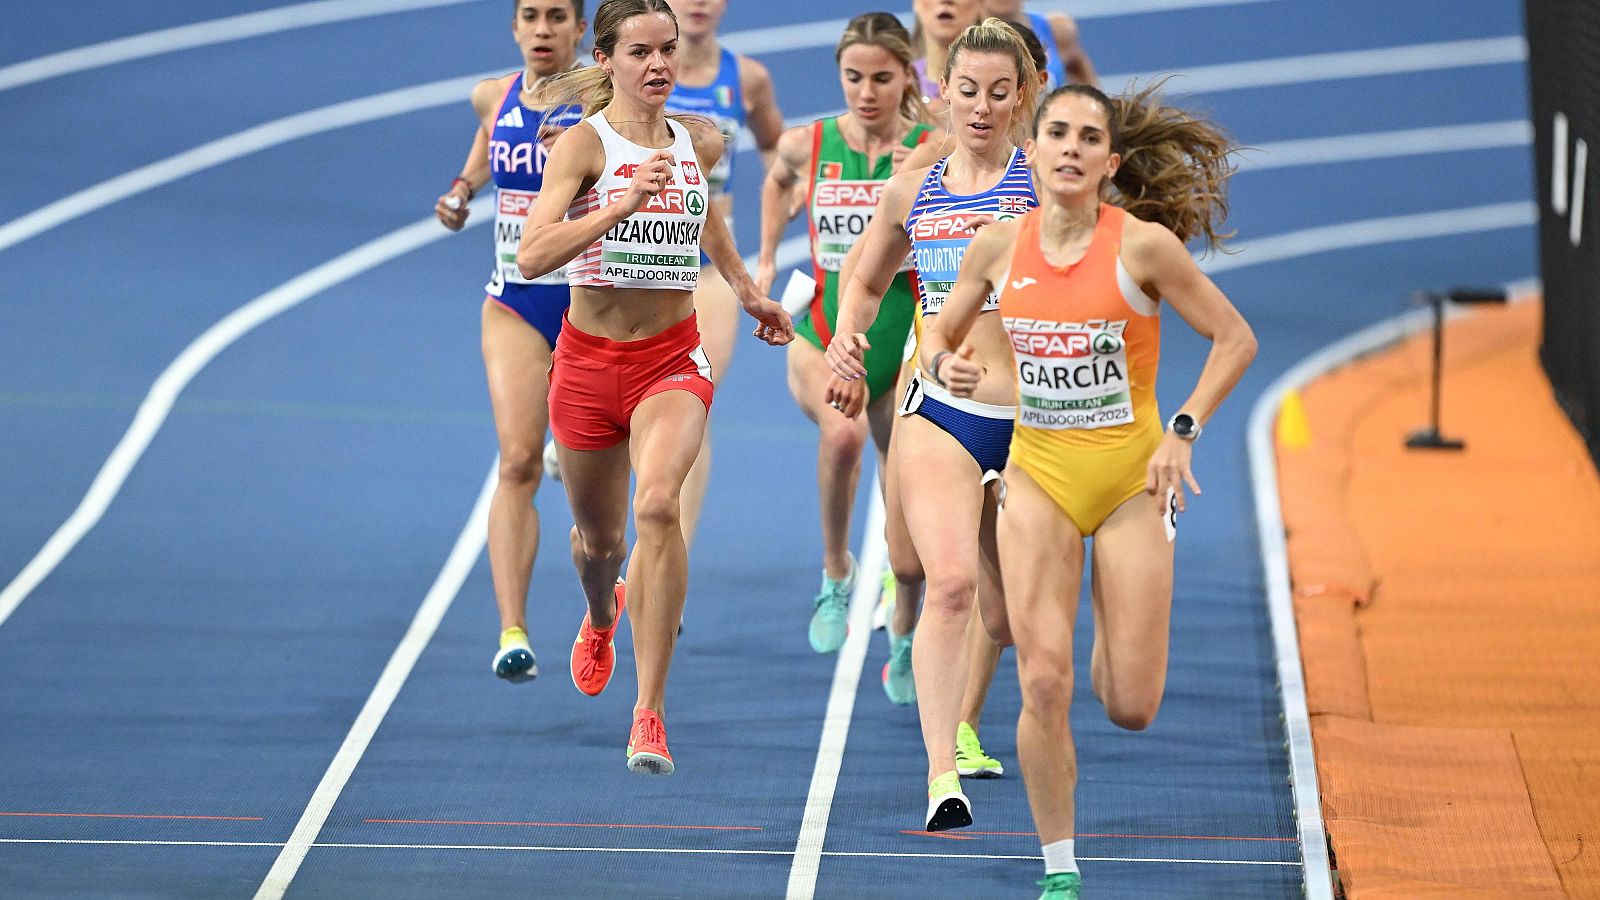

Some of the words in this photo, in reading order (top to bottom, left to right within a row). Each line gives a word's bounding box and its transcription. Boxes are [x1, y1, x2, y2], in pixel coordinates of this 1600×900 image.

[501, 194, 537, 213] SP
[819, 214, 872, 235] AFO
[917, 217, 975, 237] SPA
[626, 254, 630, 262] I
[631, 254, 655, 264] RUN
[917, 247, 966, 272] COURTNE
[605, 266, 680, 281] APELDOORN
[942, 283, 956, 292] RU
[1012, 333, 1088, 355] SPAR
[1020, 355, 1123, 390] GARCÍA
[1040, 401, 1063, 409] RUN
[1023, 410, 1095, 425] APELDOORN
[1099, 408, 1129, 422] 2025
